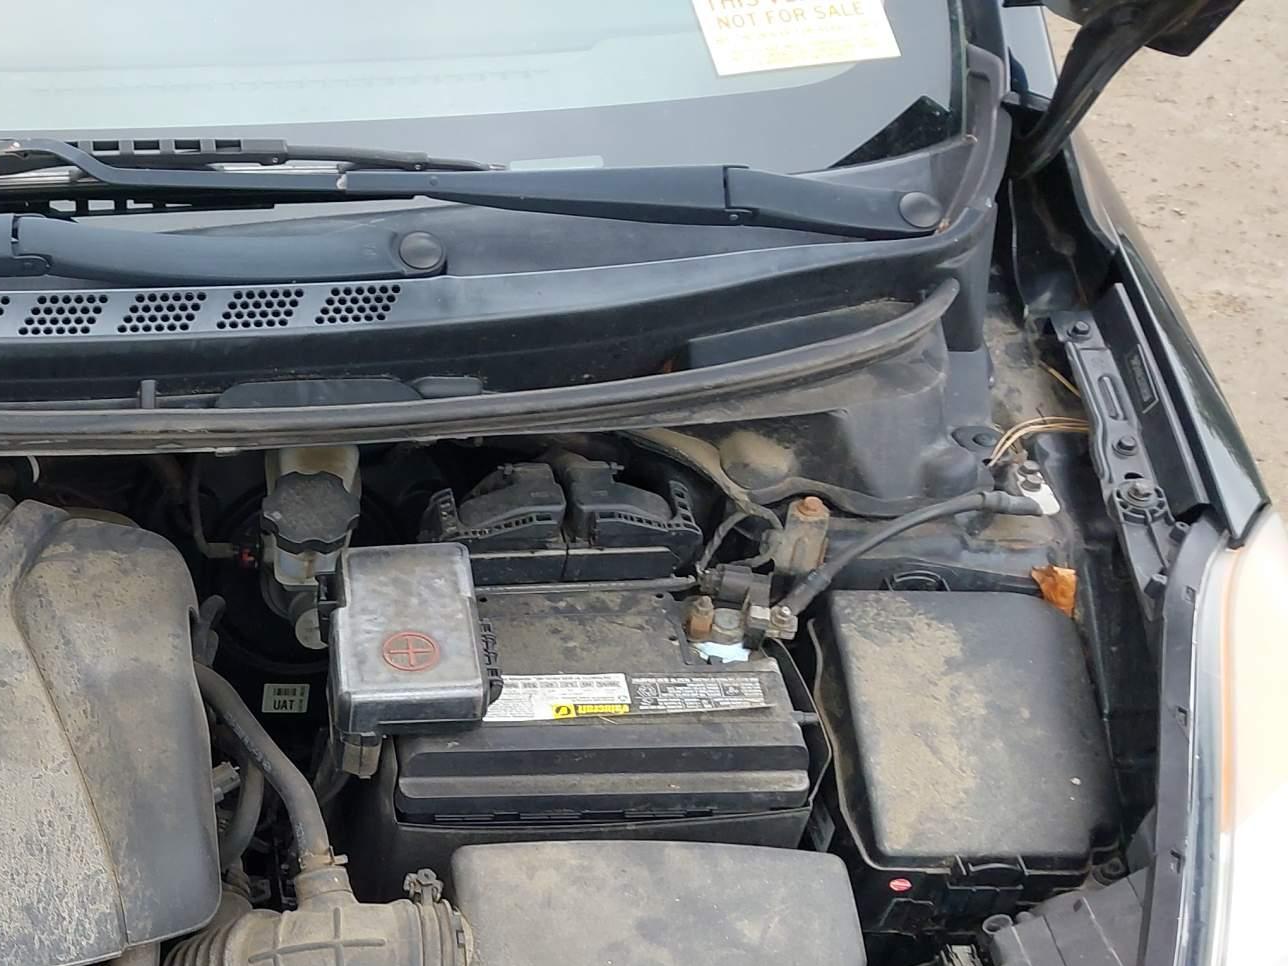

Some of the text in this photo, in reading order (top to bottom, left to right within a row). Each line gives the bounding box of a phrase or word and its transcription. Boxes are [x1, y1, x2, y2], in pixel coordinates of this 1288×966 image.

[716, 1, 864, 30] NOT FOR SALE
[273, 699, 295, 711] UAT
